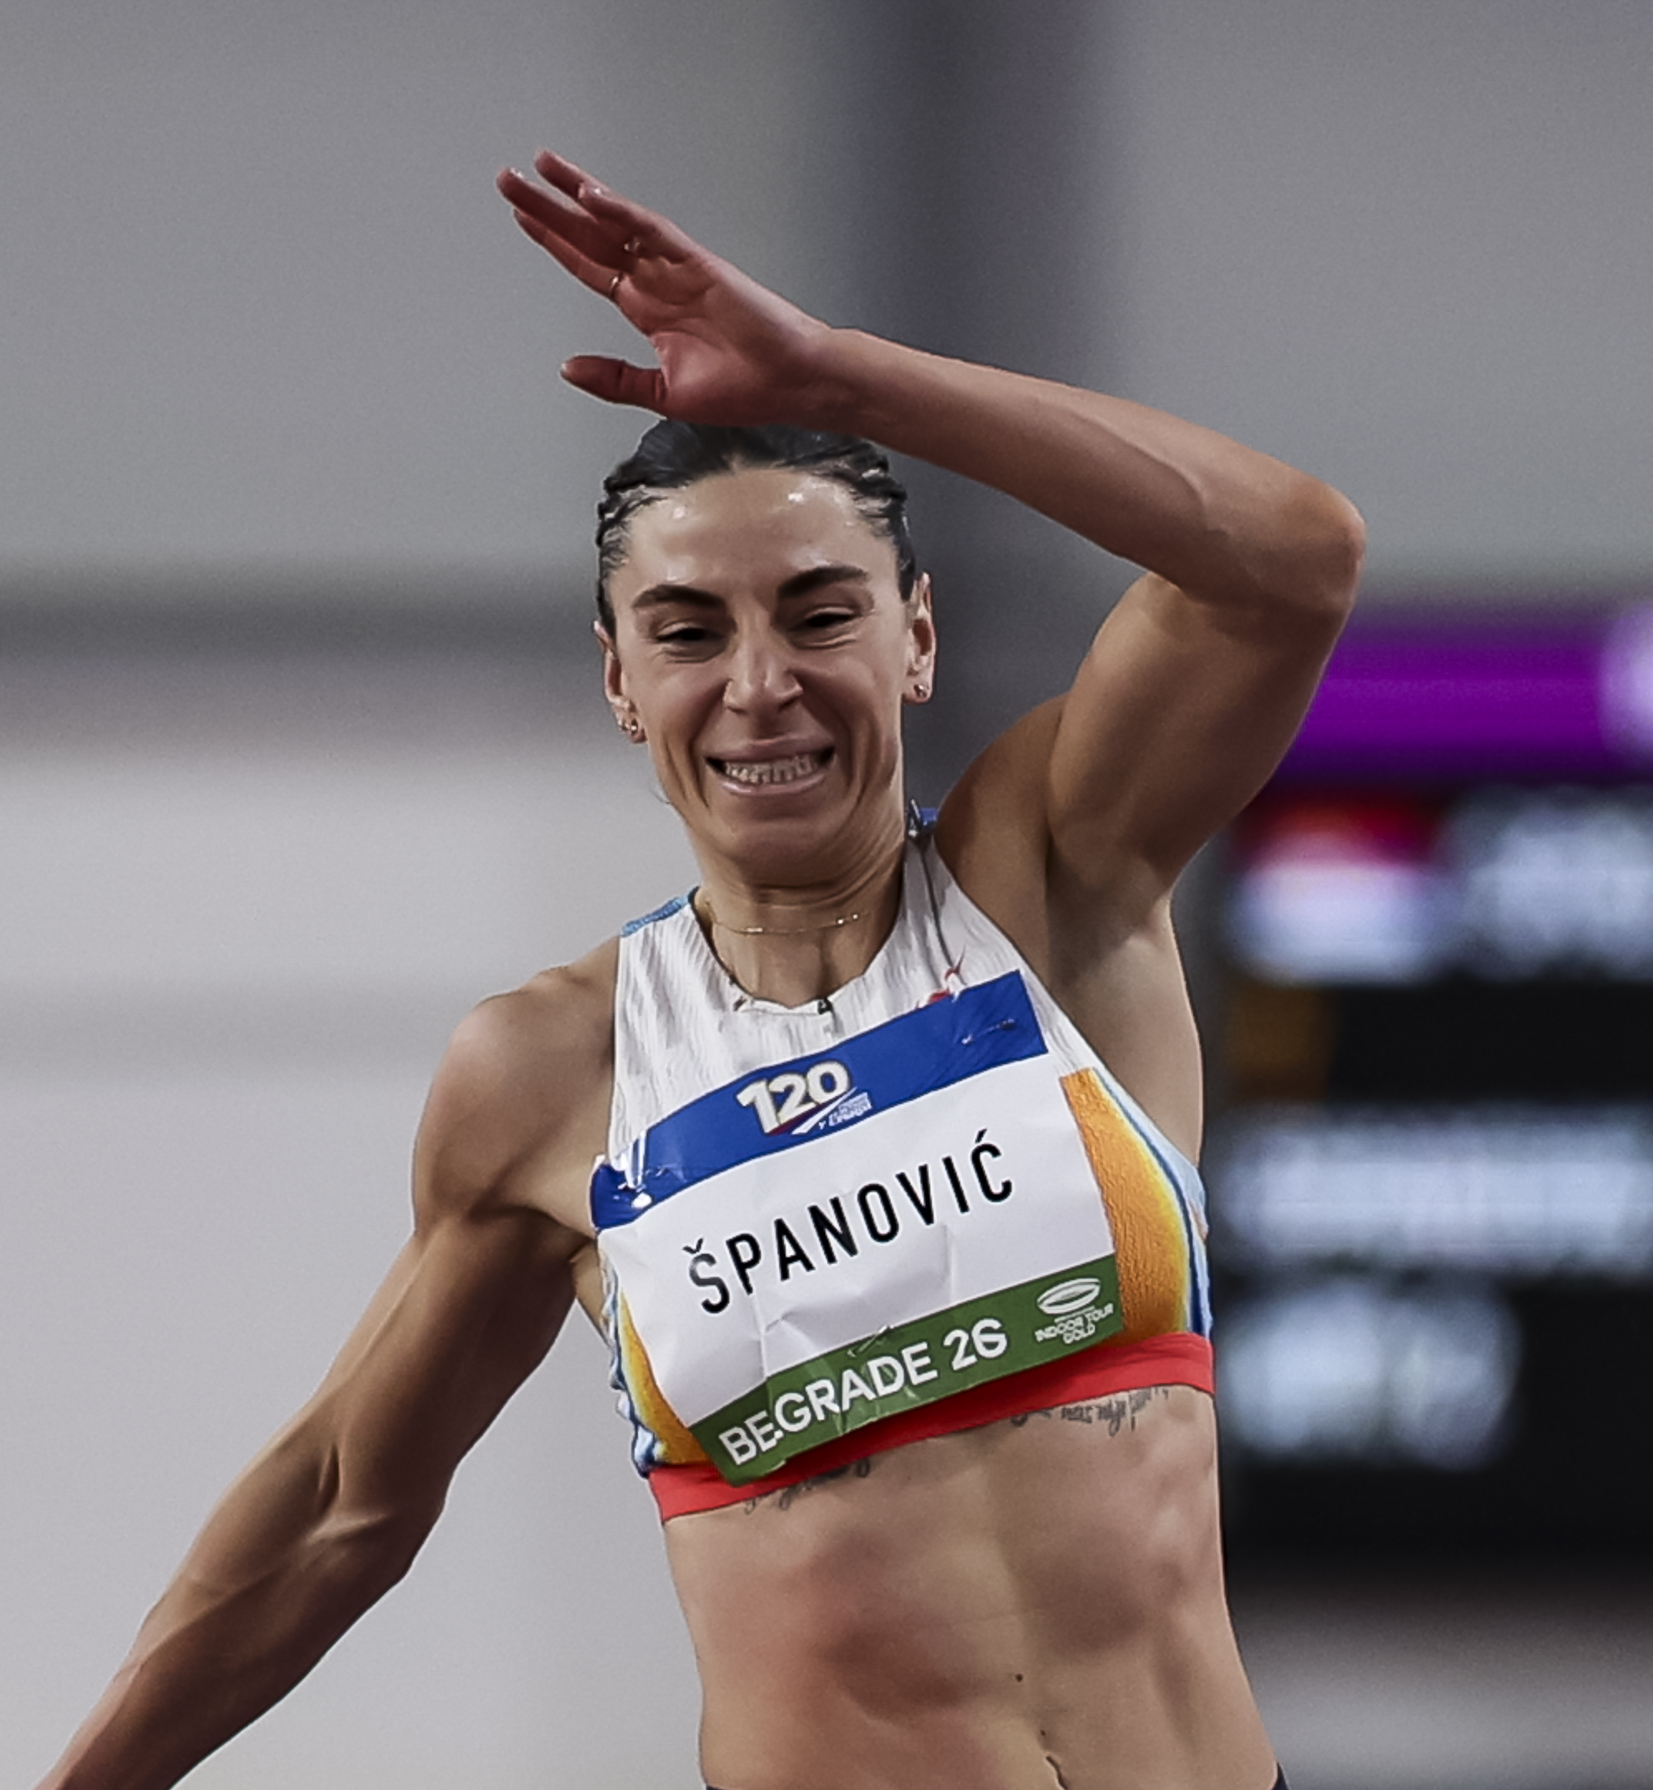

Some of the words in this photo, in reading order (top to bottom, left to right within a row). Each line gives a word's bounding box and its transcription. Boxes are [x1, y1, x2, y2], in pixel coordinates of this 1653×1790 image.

[736, 1060, 851, 1134] 120
[682, 1128, 1013, 1314] ŠPANOVIĆ
[943, 1318, 1008, 1371] 26
